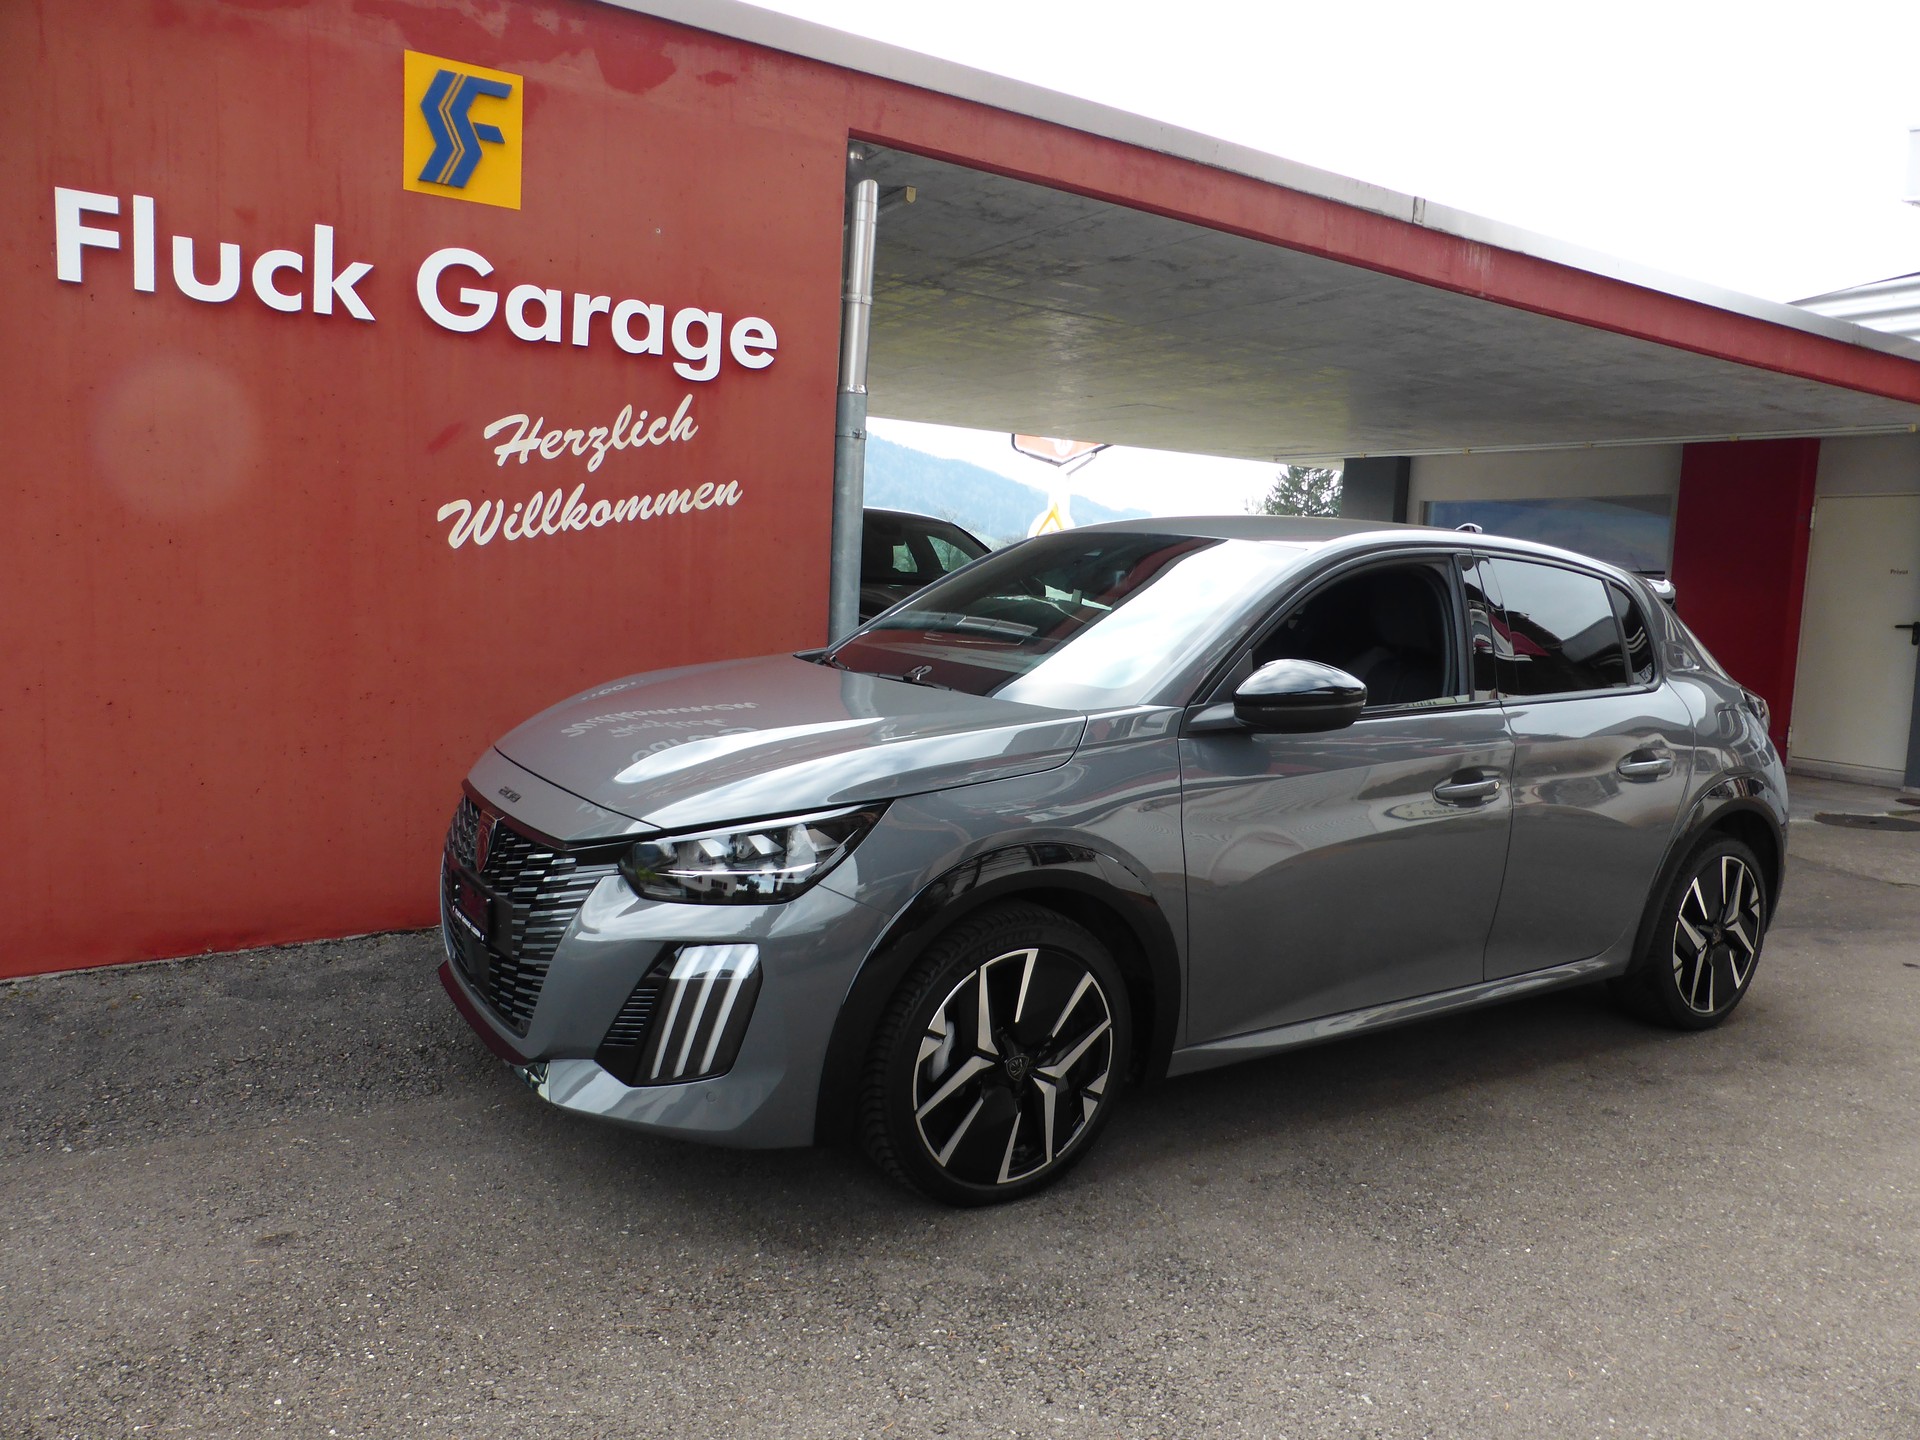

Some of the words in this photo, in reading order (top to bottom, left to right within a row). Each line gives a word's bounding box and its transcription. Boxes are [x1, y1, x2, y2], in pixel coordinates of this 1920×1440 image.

[54, 186, 376, 321] Fluck
[416, 247, 779, 382] Garage
[483, 393, 699, 473] Herzlich
[437, 480, 743, 549] Willkommen
